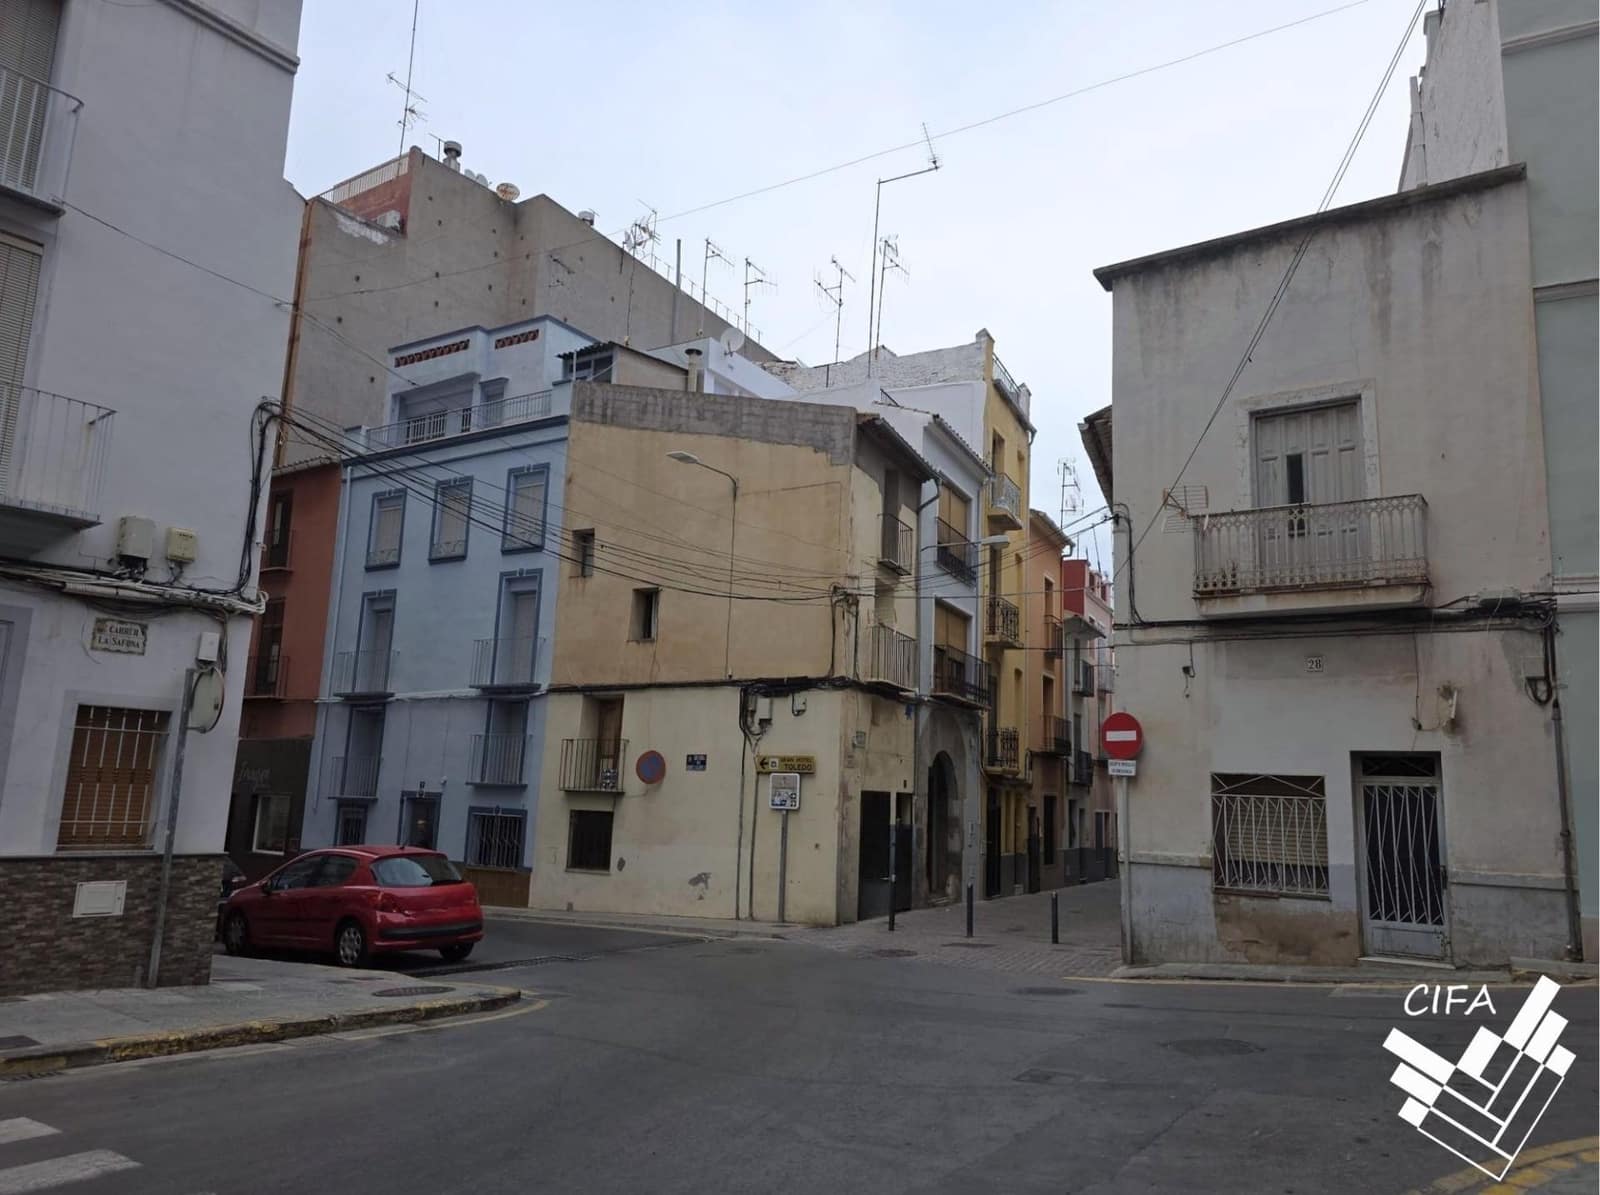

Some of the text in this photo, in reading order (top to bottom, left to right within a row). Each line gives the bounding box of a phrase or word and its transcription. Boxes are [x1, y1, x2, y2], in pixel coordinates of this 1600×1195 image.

[98, 636, 109, 645] LA
[1308, 658, 1321, 669] 28
[784, 763, 813, 771] TOLEDO
